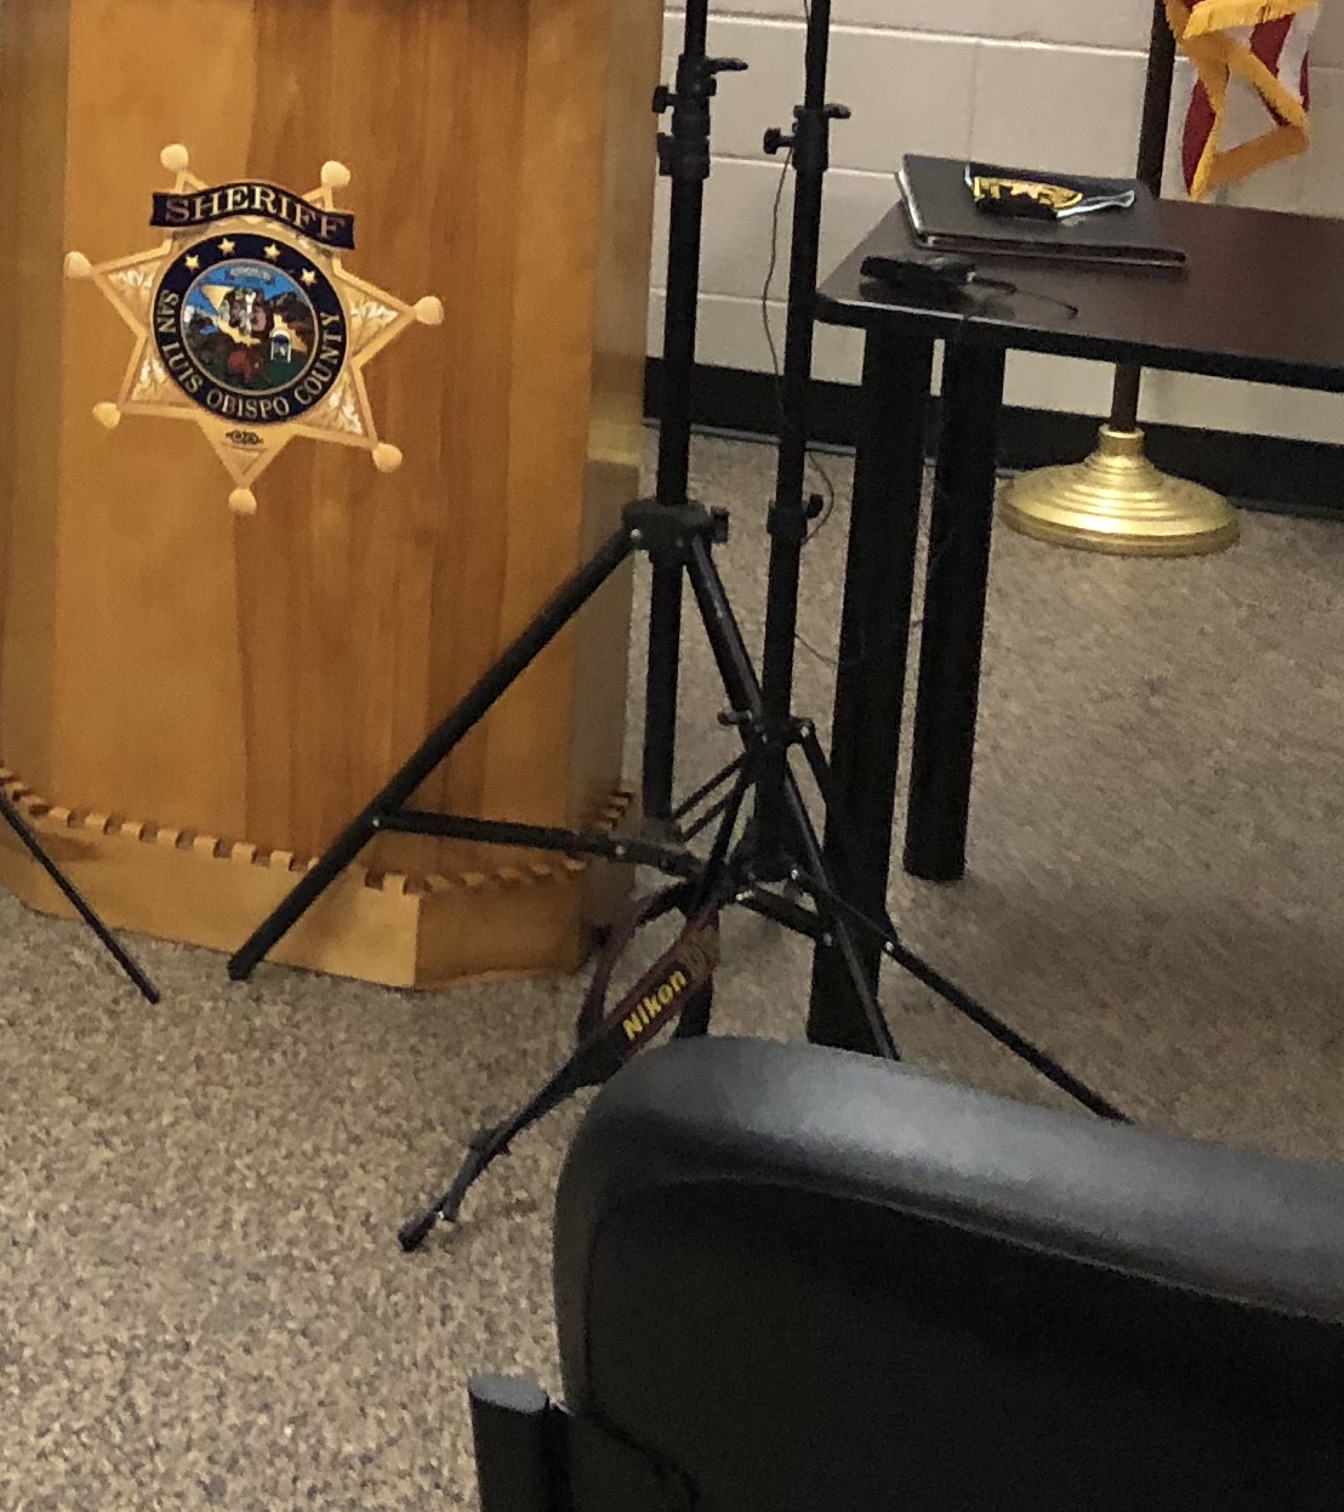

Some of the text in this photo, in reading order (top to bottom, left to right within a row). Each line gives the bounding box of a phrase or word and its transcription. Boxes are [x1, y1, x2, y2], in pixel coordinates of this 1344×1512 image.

[164, 183, 345, 240] SHERIFF
[155, 291, 341, 421] SAN LUIS OBISPO COUNTY
[622, 970, 687, 1042] Nikon
